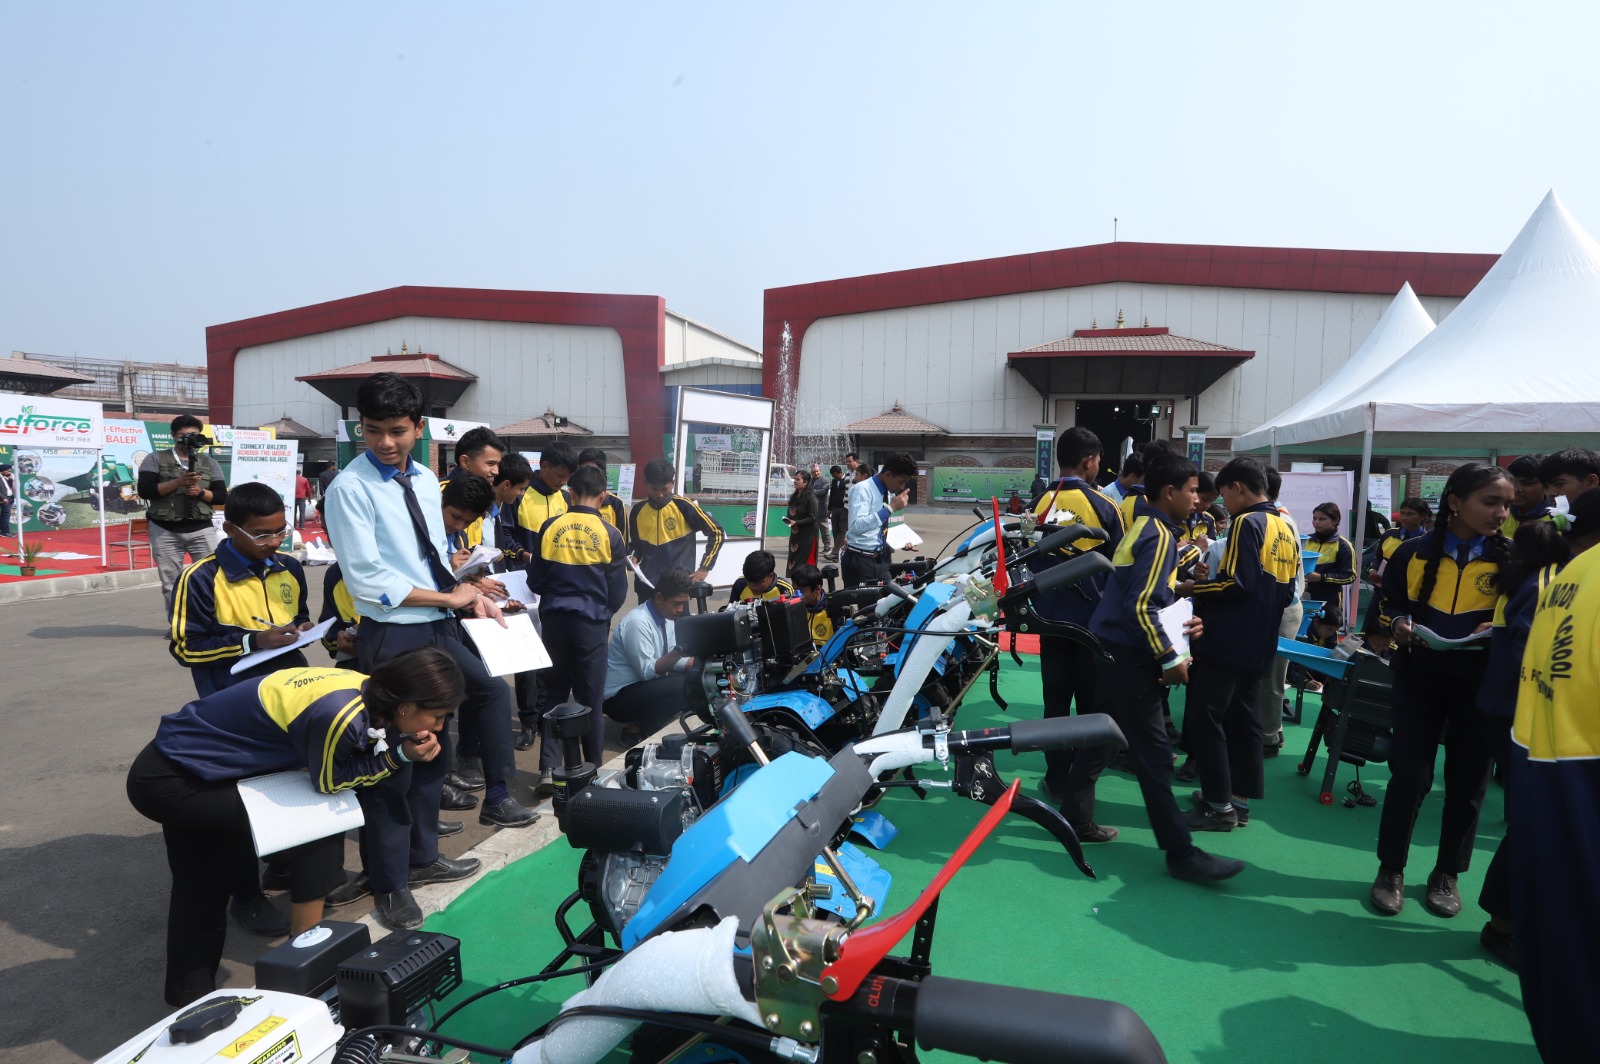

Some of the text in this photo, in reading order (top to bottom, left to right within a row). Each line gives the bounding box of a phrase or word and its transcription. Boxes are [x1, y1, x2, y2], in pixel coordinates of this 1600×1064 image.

[0, 414, 91, 435] dforce
[103, 426, 144, 434] t-Effective
[105, 435, 137, 444] BALER
[1041, 441, 1049, 477] HALL
[868, 975, 887, 1007] CLUT
[256, 1040, 287, 1064] WARNING
